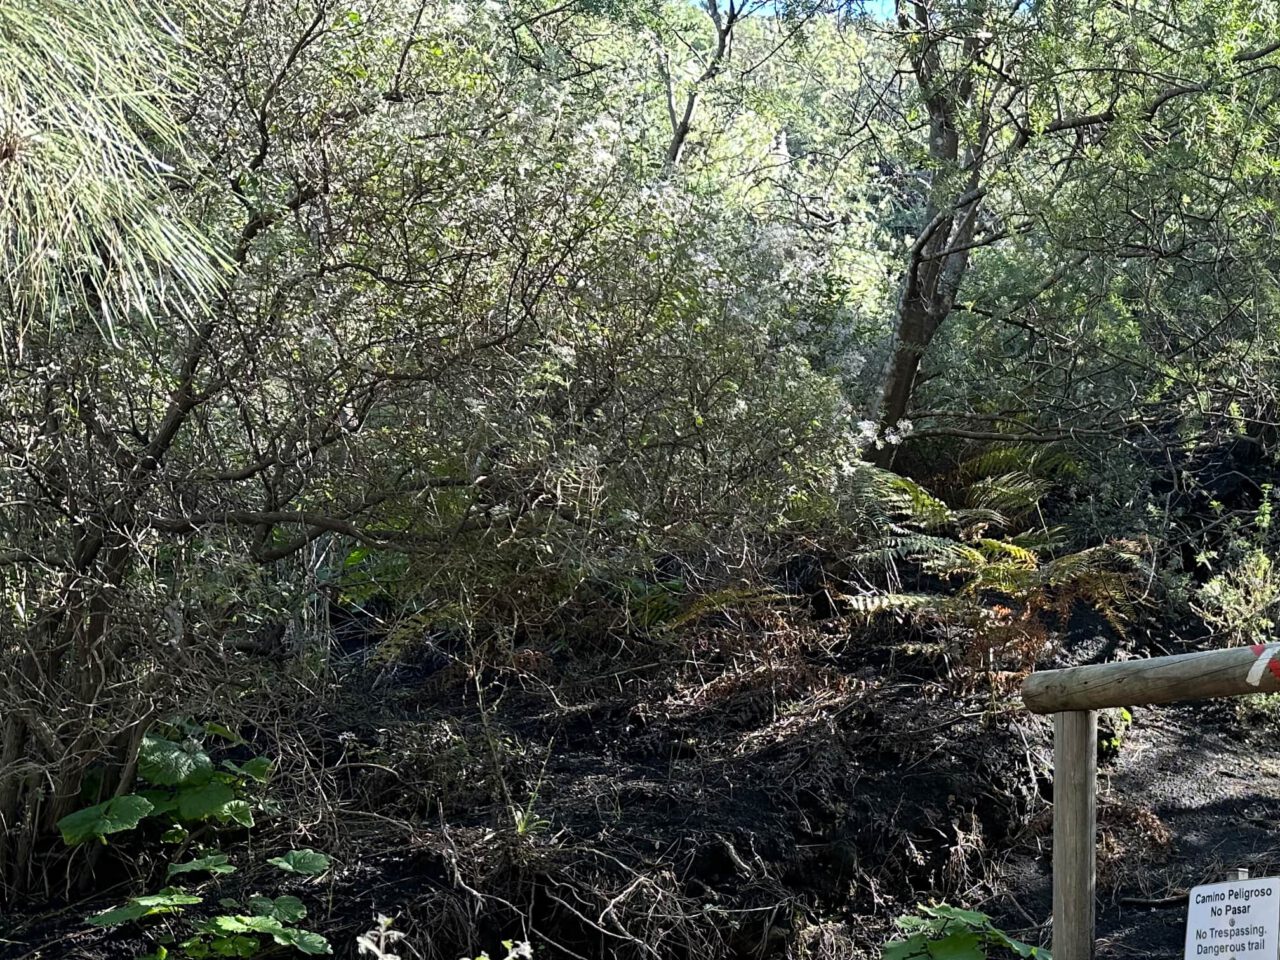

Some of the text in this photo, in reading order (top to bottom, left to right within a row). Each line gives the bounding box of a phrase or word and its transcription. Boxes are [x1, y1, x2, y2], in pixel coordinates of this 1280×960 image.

[1195, 887, 1272, 904] Camino Peligroso
[1211, 904, 1251, 917] No Pasar
[1196, 929, 1207, 940] No
[1197, 939, 1265, 956] Dangerous trail
